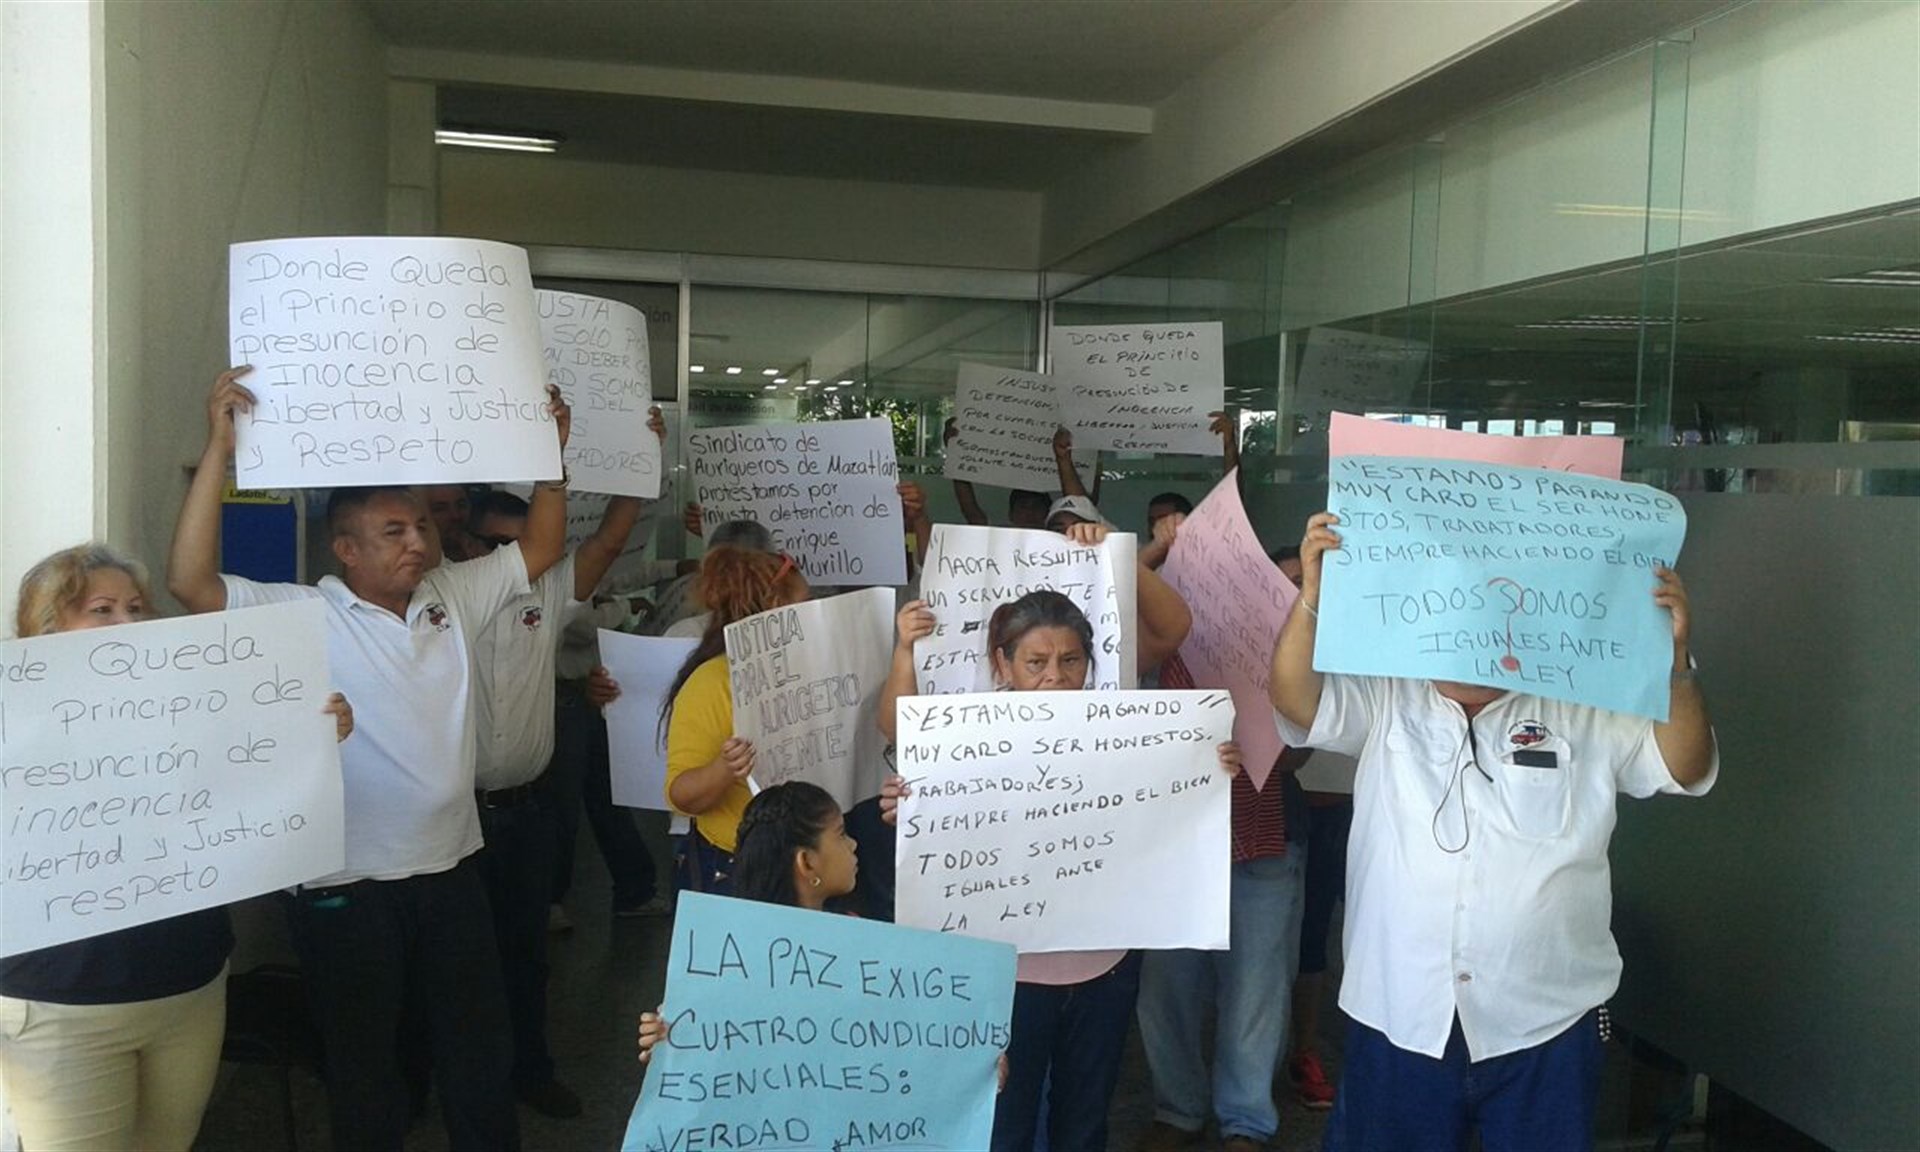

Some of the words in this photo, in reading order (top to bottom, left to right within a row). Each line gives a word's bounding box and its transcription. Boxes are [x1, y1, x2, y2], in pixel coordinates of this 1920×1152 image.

[247, 249, 369, 283] Donde
[390, 249, 510, 287] Queda
[240, 295, 265, 326] el
[465, 291, 505, 324] de
[537, 292, 610, 321] USTA
[455, 326, 499, 353] de
[552, 324, 612, 349] SOLO
[573, 349, 631, 370] DEBER
[1086, 354, 1108, 364] EL
[268, 362, 483, 387] Inocencia
[549, 368, 576, 387] AD
[250, 391, 406, 425] Libertad
[419, 402, 431, 425] y
[588, 391, 634, 412] DEL
[690, 429, 788, 456] Sindicato
[796, 431, 821, 452] de
[1011, 431, 1053, 446] SOCIED
[244, 445, 265, 471] y
[563, 447, 654, 475] ADORES
[798, 455, 821, 475] de
[808, 481, 838, 502] por
[1337, 481, 1391, 503] MUY
[1406, 485, 1478, 509] CARO
[1488, 496, 1525, 513] EL
[1542, 502, 1593, 516] SER
[1600, 503, 1670, 524] HONE
[1535, 476, 1674, 510] PAGANDO
[863, 495, 890, 519] de
[795, 550, 864, 576] Murillo
[1336, 541, 1454, 566] SIEMPRE
[1464, 544, 1594, 562] HACIENDO
[1604, 548, 1627, 565] EL
[1363, 584, 1485, 626] TODOS
[1499, 584, 1608, 621] SOMOS
[0, 649, 47, 682] de
[88, 622, 263, 680] Queda
[1419, 631, 1550, 654] IGUALES
[1560, 635, 1628, 659] ANTE
[251, 664, 303, 705] de
[1515, 661, 1576, 690] LEY
[0, 742, 198, 788] resunción
[227, 731, 277, 763] de
[904, 743, 941, 764] MUY
[950, 740, 1013, 762] CARO
[1031, 737, 1083, 756] SER
[11, 788, 212, 836] inocencia
[904, 809, 1009, 839] SIEMPRE
[1025, 793, 1123, 822] HACIENDO
[1135, 788, 1159, 802] EL
[1171, 774, 1211, 795] BIEN
[0, 835, 125, 885] ibertad
[144, 837, 168, 861] y
[183, 811, 306, 851] Justicia
[919, 848, 1002, 876] TODOS
[1027, 830, 1115, 858] SOMOS
[944, 874, 1031, 899] IGUALES
[1055, 859, 1104, 880] ANTE
[941, 912, 968, 932] LA
[1000, 900, 1047, 921] LEY
[686, 929, 749, 979] LA
[768, 937, 843, 989] PAZ
[860, 959, 972, 1001] EXIGE
[667, 1008, 817, 1051] CUATRO
[831, 1016, 1010, 1050] CONDICIONES
[658, 1063, 912, 1102] ESENCIALES:
[657, 1117, 810, 1152] VERDAD
[847, 1116, 927, 1146] AMOR
